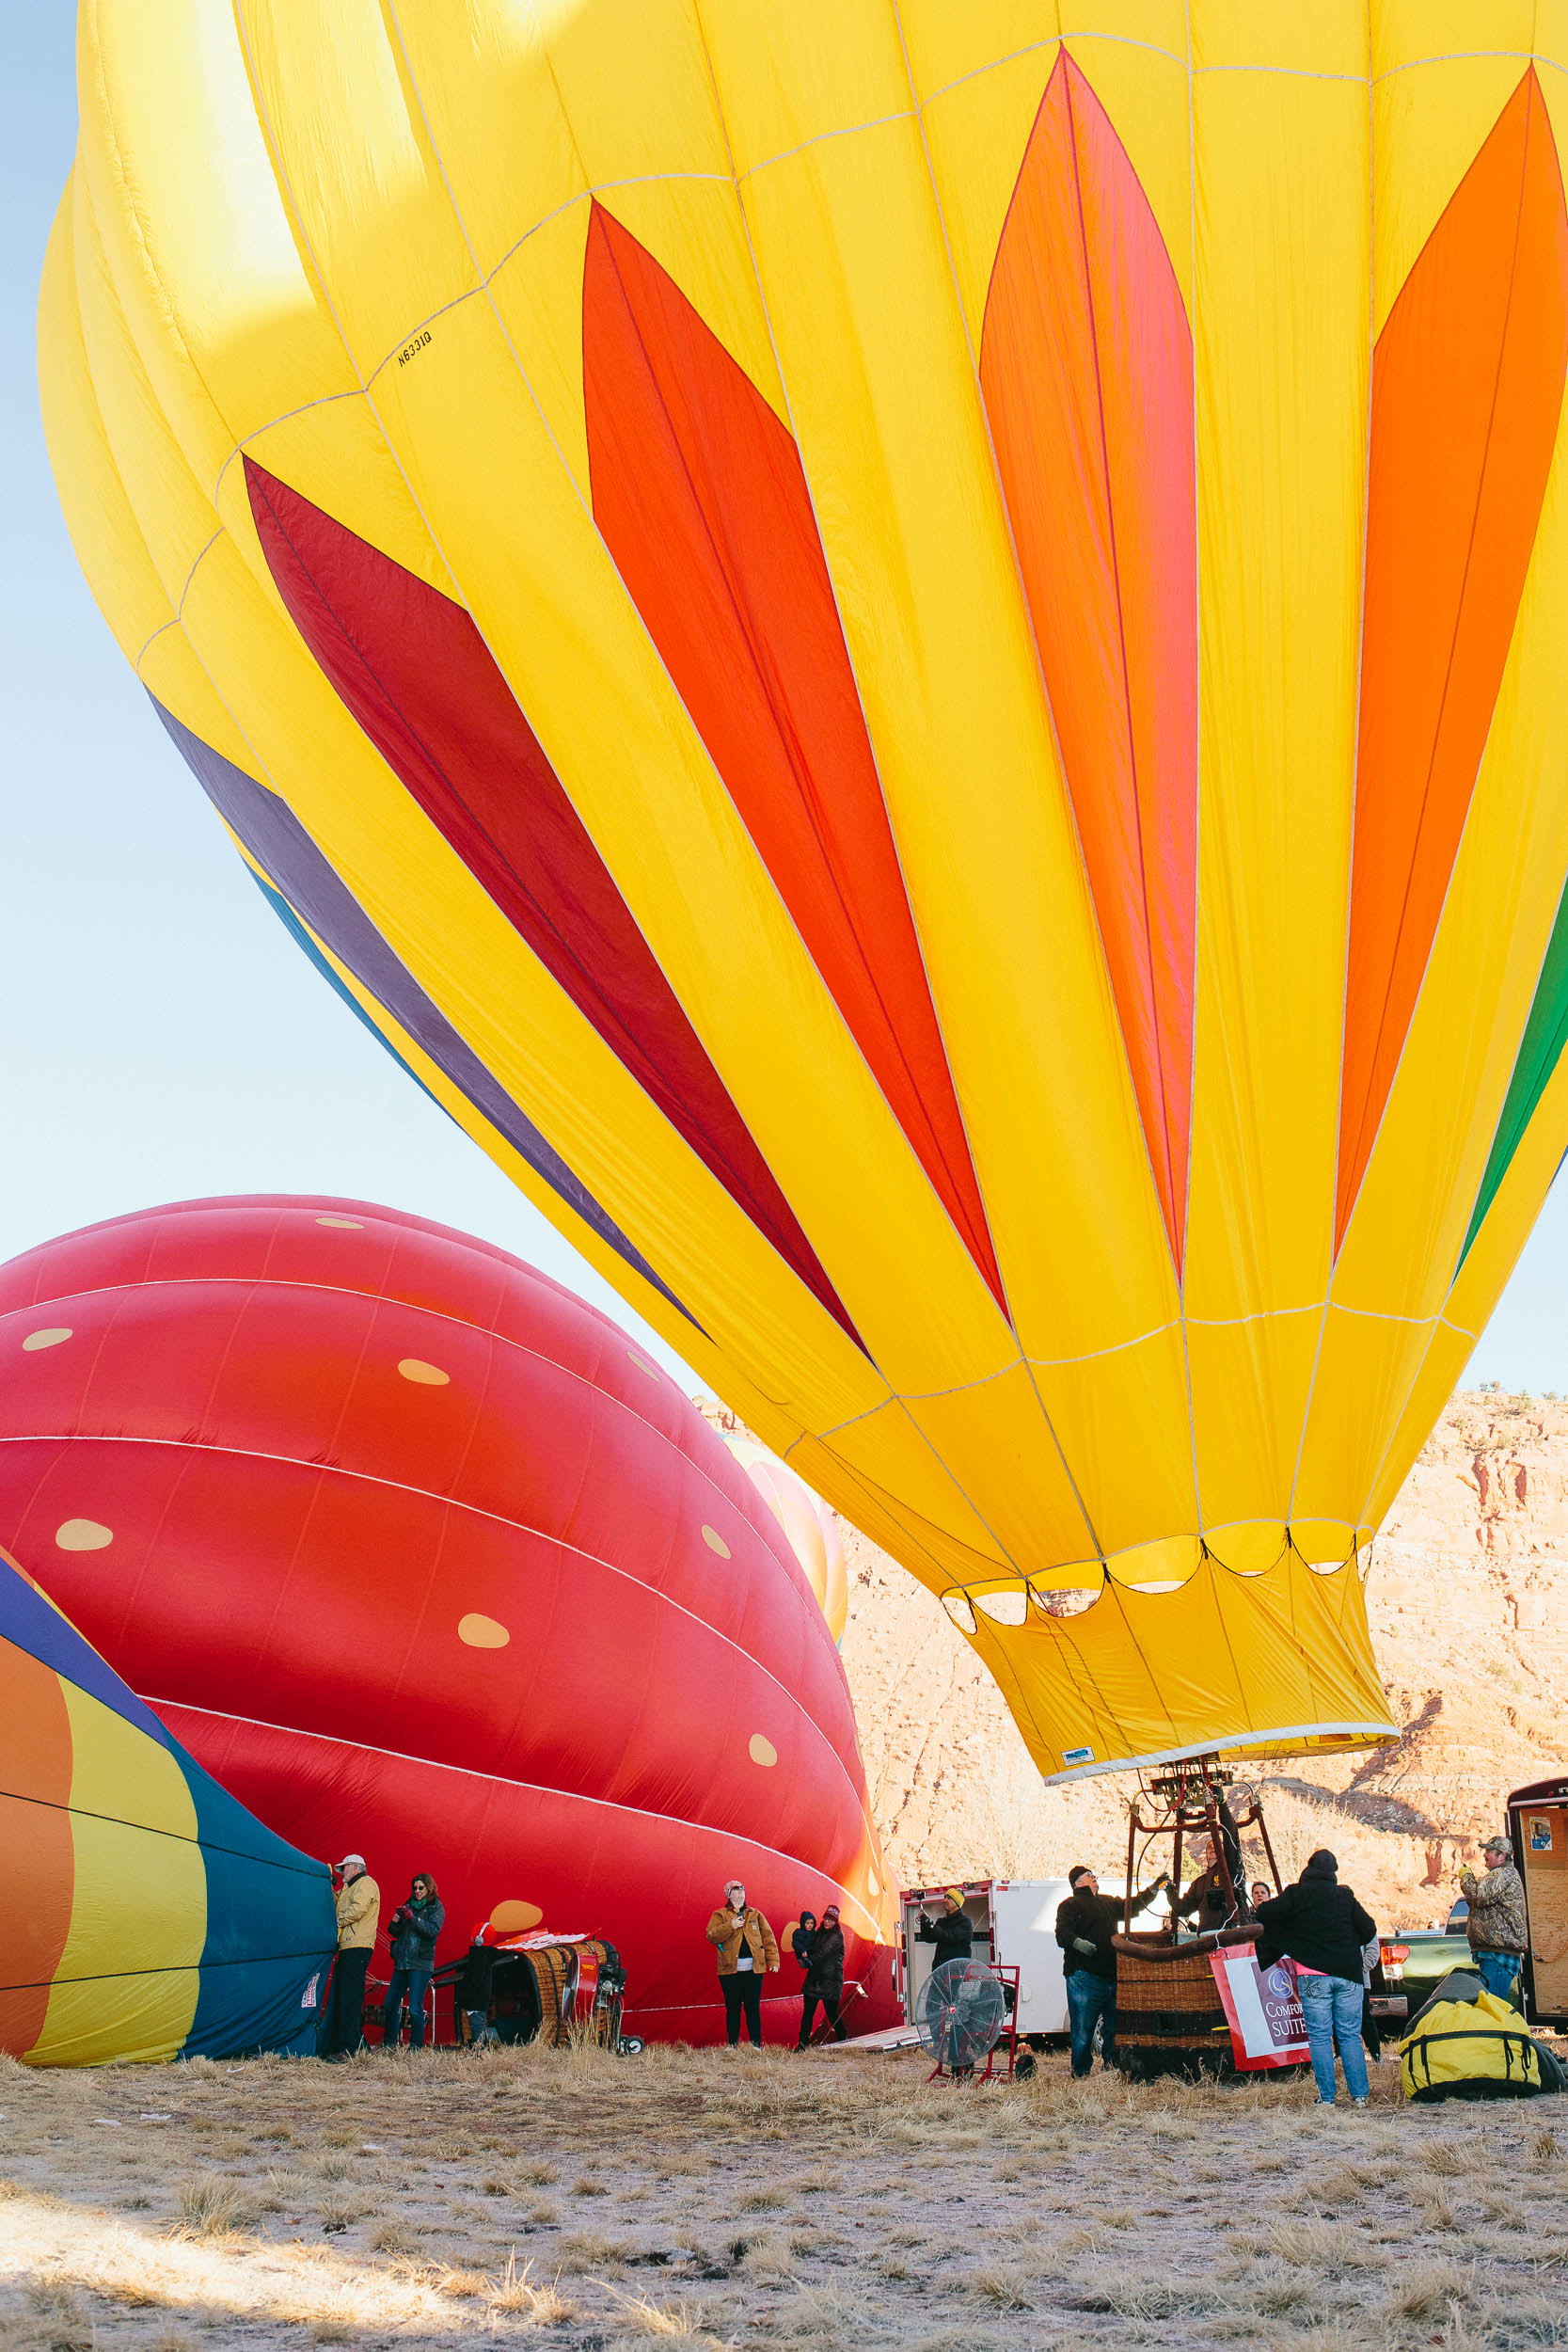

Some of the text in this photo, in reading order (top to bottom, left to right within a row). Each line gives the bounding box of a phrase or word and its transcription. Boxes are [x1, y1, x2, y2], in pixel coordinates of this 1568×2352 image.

[398, 331, 432, 367] N6331Q
[1265, 2002, 1304, 2018] COMFOR
[1272, 2018, 1307, 2037] SUITE
